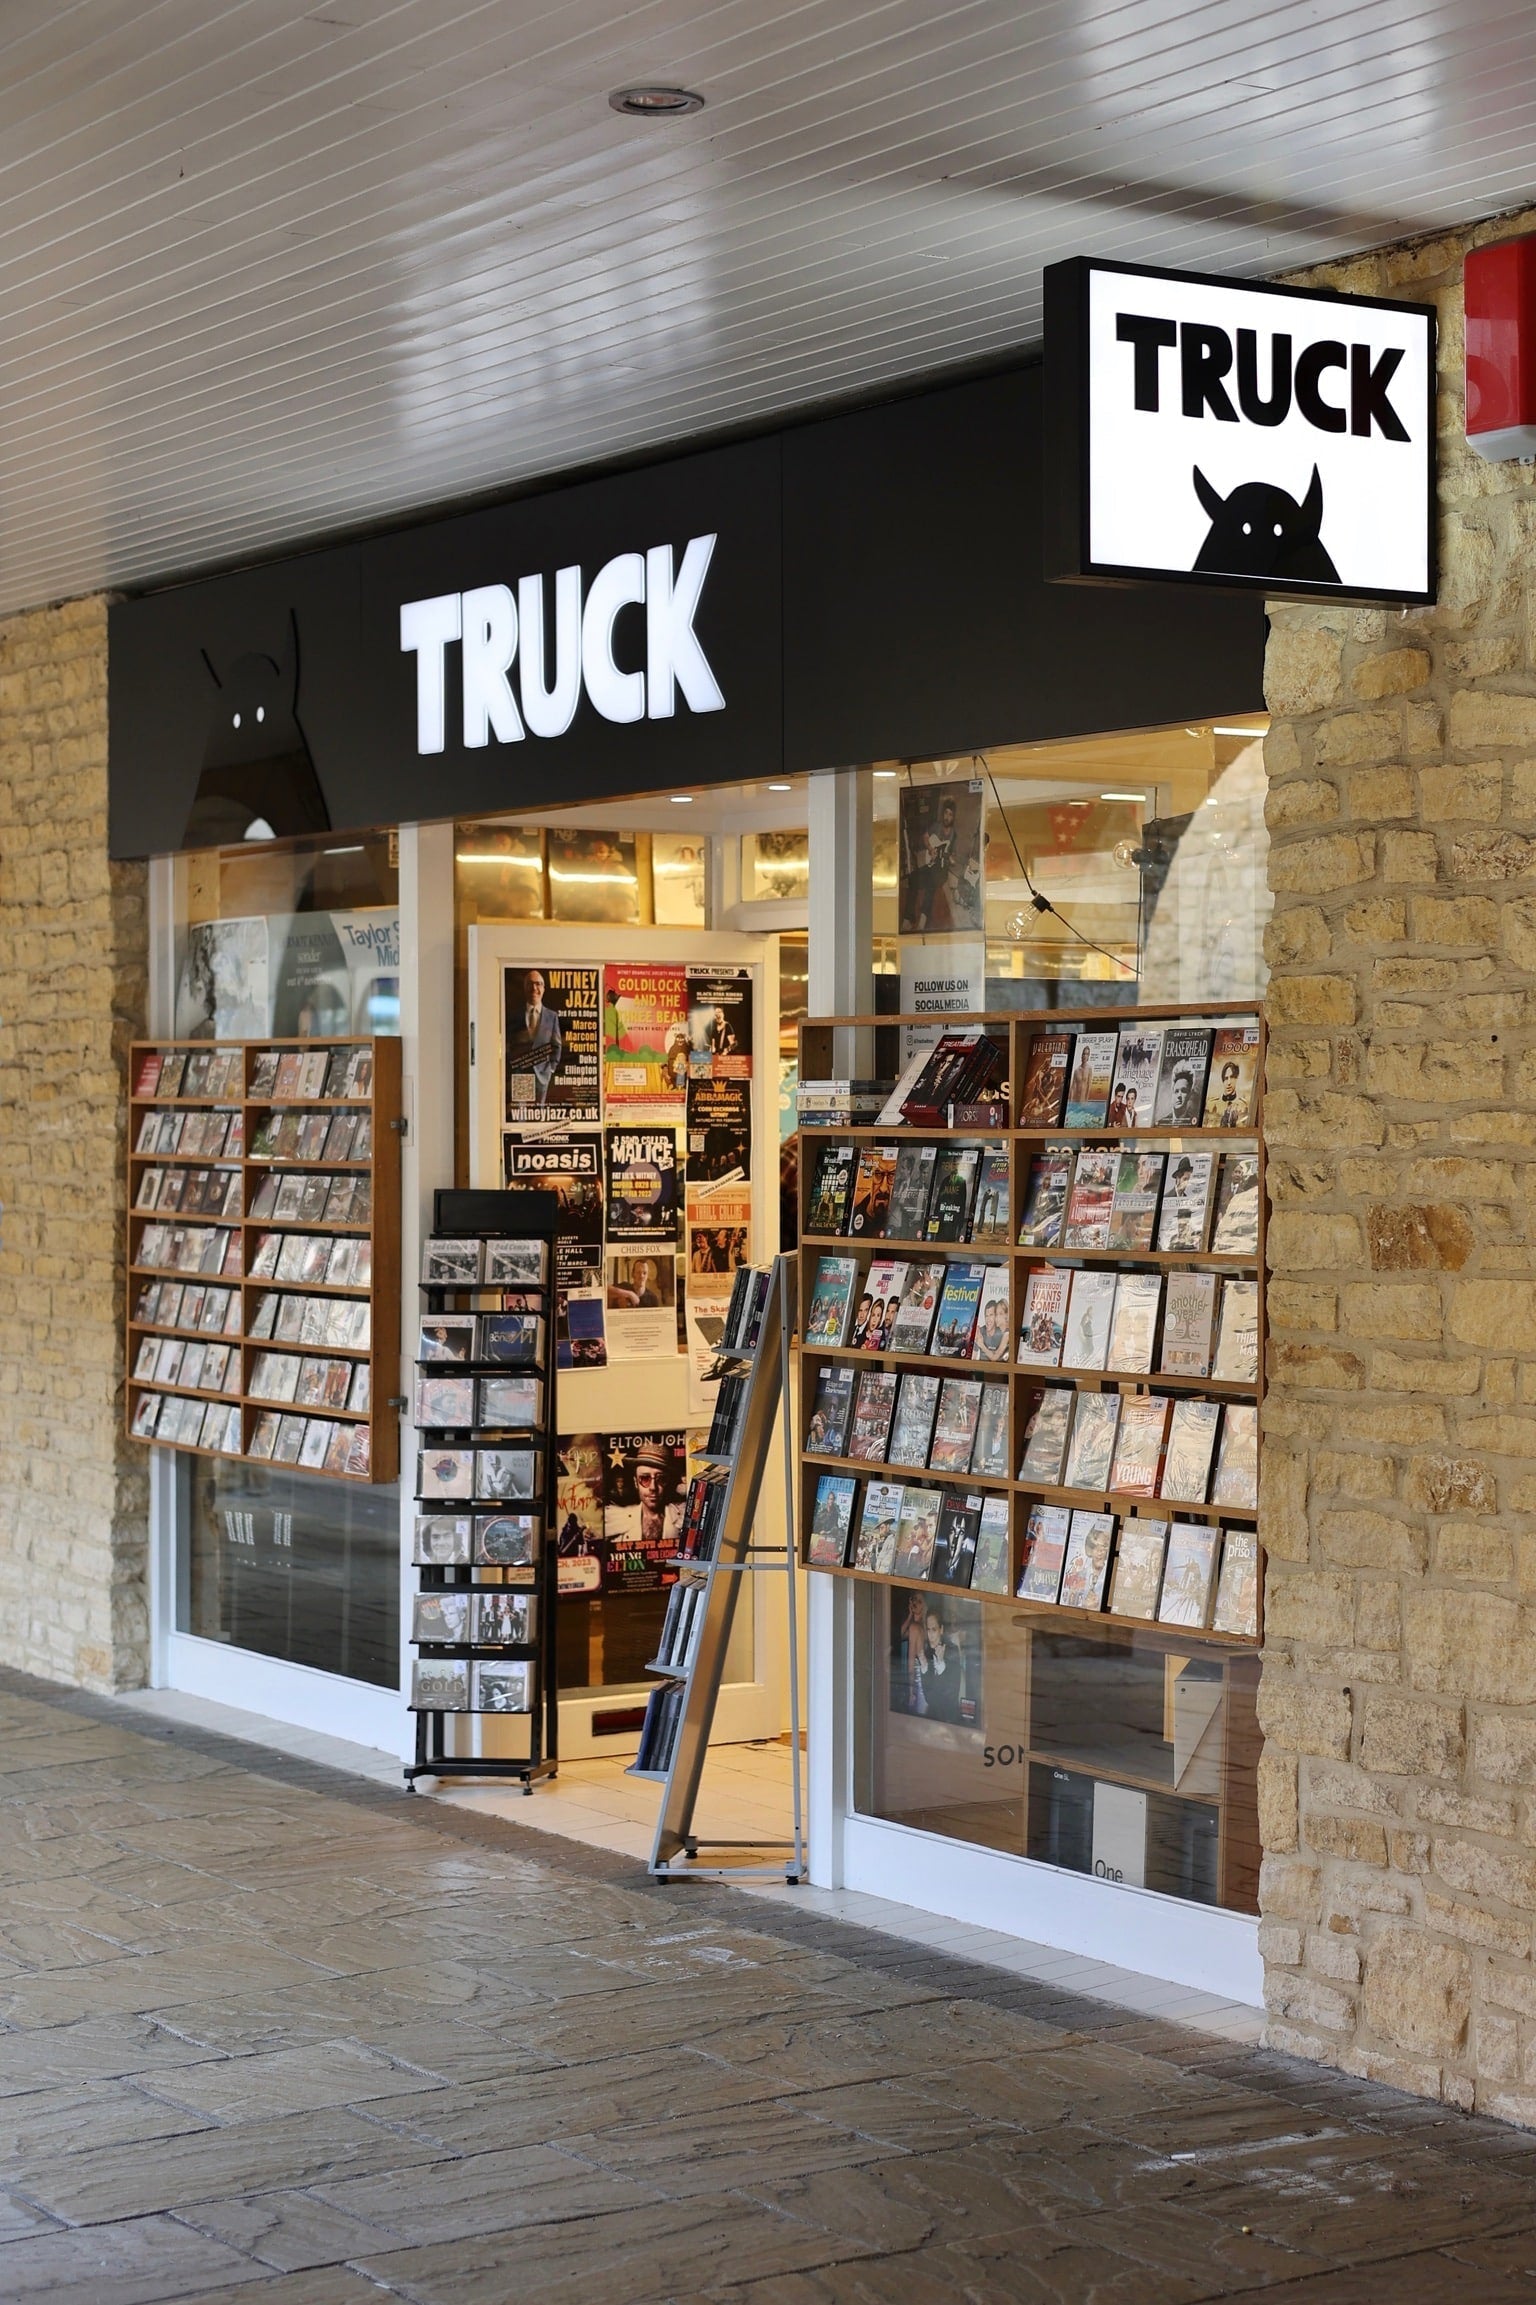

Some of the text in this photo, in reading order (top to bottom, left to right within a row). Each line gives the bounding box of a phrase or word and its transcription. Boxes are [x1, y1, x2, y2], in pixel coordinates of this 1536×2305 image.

[1116, 312, 1411, 443] TRUCK
[400, 533, 726, 755] TRUCK
[342, 923, 390, 949] Taylor
[549, 971, 597, 989] WITNEY
[914, 980, 968, 991] FOLLOW US ON
[565, 990, 597, 1008] JAZZ
[634, 993, 656, 1007] AND
[660, 994, 680, 1007] THE
[915, 998, 969, 1010] SOCIAL MEDIA
[656, 1010, 686, 1023] BEAR
[572, 1020, 597, 1030] Marco
[565, 1031, 597, 1041] Marconi
[1165, 1040, 1208, 1057] ERASERHEAD
[1221, 1043, 1250, 1053] 1900
[579, 1054, 597, 1064] Duke
[565, 1065, 597, 1075] Ellington
[1117, 1069, 1155, 1083] Language
[554, 1076, 597, 1086] Reimagined
[695, 1092, 743, 1102] ABBAMAGIC
[511, 1107, 598, 1121] witneyjazz.co.uk
[517, 1149, 592, 1169] noasis
[611, 1143, 673, 1164] MALICE
[940, 1203, 960, 1212] Breaking
[621, 1245, 661, 1254] CHRIS FOX
[989, 1286, 1009, 1296] WOME
[1033, 1281, 1062, 1291] EVERYBODY
[943, 1284, 980, 1302] festival
[1032, 1290, 1062, 1302] WANTS
[1030, 1300, 1060, 1313] SOME!!
[1171, 1294, 1208, 1312] another
[1177, 1308, 1199, 1320] year
[609, 1434, 685, 1449] ELTON JOH
[1116, 1464, 1152, 1485] YOUNG
[1235, 1534, 1248, 1547] the
[609, 1552, 642, 1561] YOUNG
[1228, 1544, 1250, 1561] priso
[607, 1559, 645, 1572] ELTON
[420, 1681, 465, 1693] GOLD
[1053, 1772, 1064, 1780] One
[1094, 1859, 1123, 1883] One
